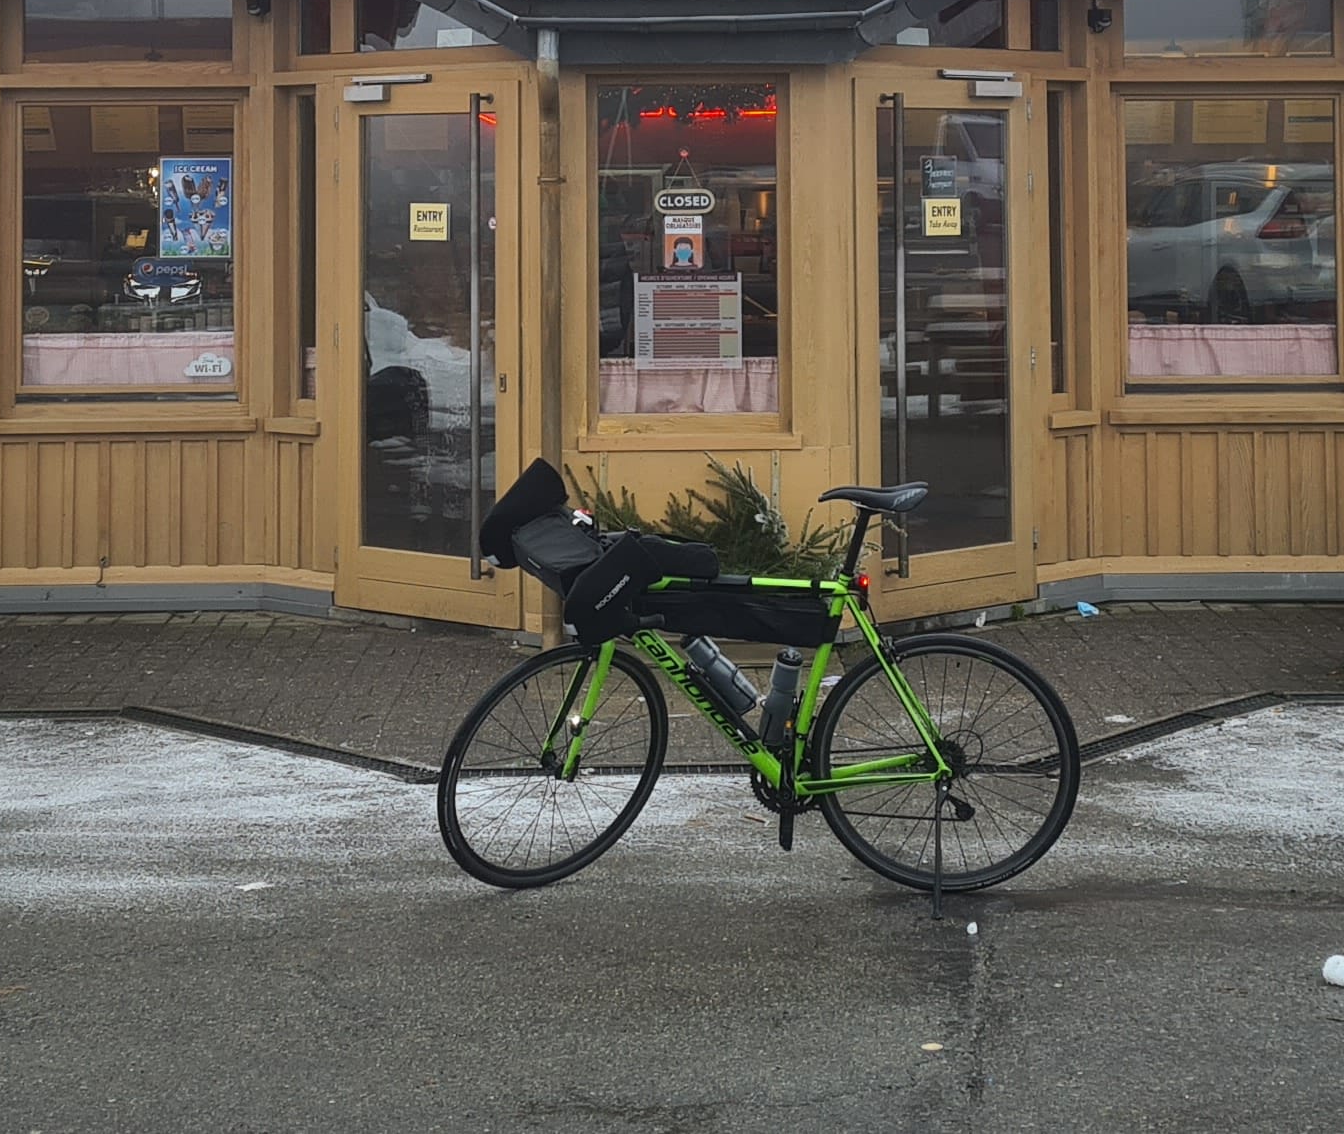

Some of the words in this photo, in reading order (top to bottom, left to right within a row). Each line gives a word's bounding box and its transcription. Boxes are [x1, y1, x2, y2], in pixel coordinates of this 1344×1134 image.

[659, 195, 710, 207] CLOSED
[416, 210, 443, 222] ENTRY
[931, 206, 957, 217] ENTRY
[156, 264, 188, 275] pepsi
